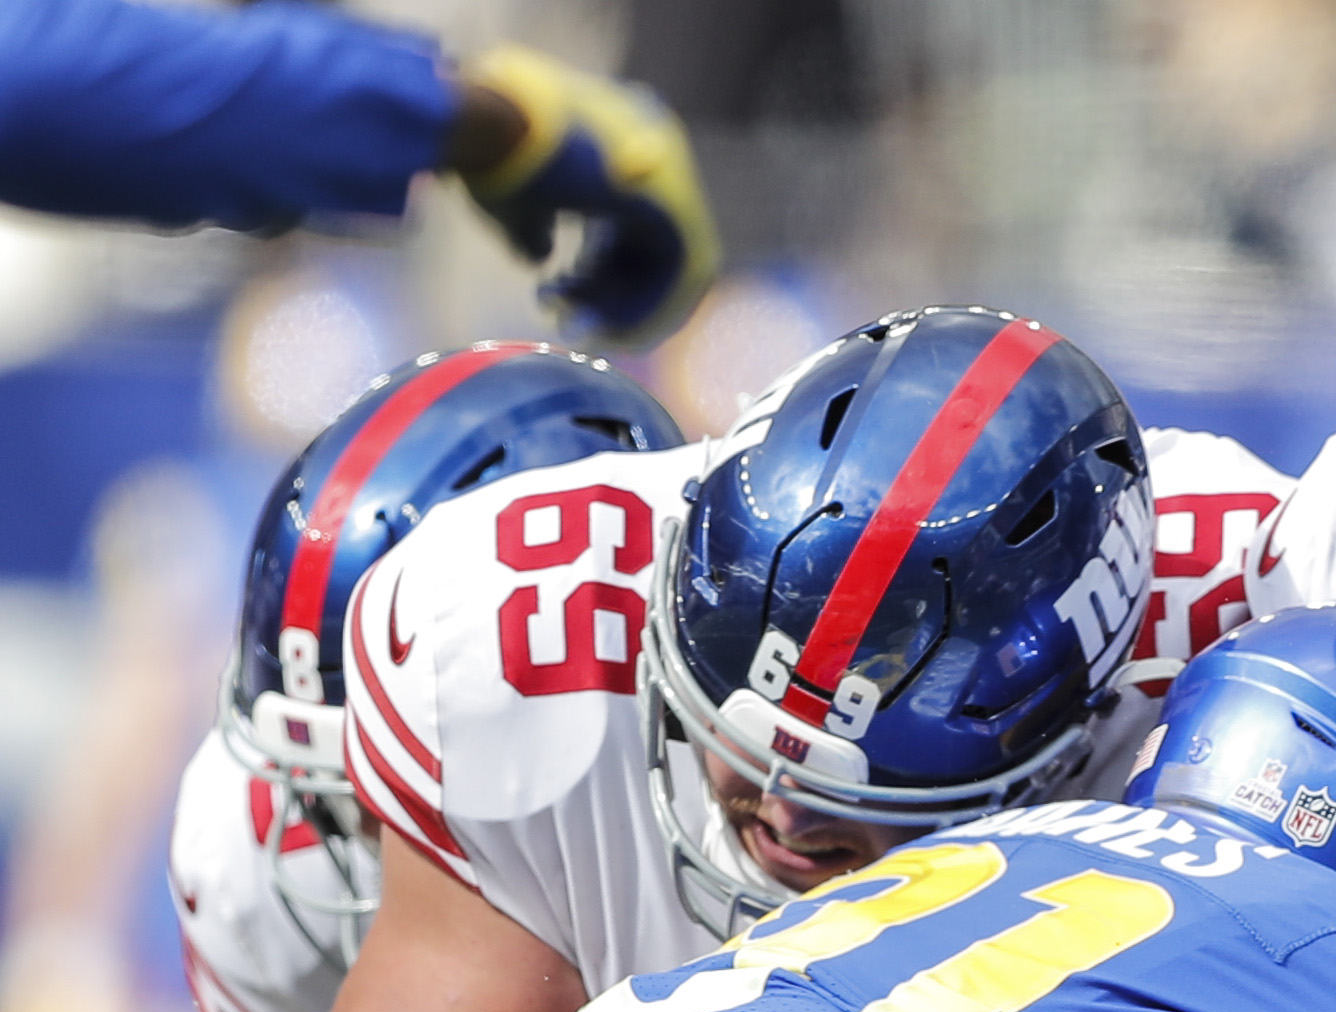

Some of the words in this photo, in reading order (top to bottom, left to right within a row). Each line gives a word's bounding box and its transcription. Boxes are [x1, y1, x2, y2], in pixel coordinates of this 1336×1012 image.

[496, 484, 654, 697] 69
[279, 626, 325, 703] 8
[747, 630, 882, 741] 69
[1234, 784, 1284, 814] CATCH
[1289, 808, 1324, 840] NFL
